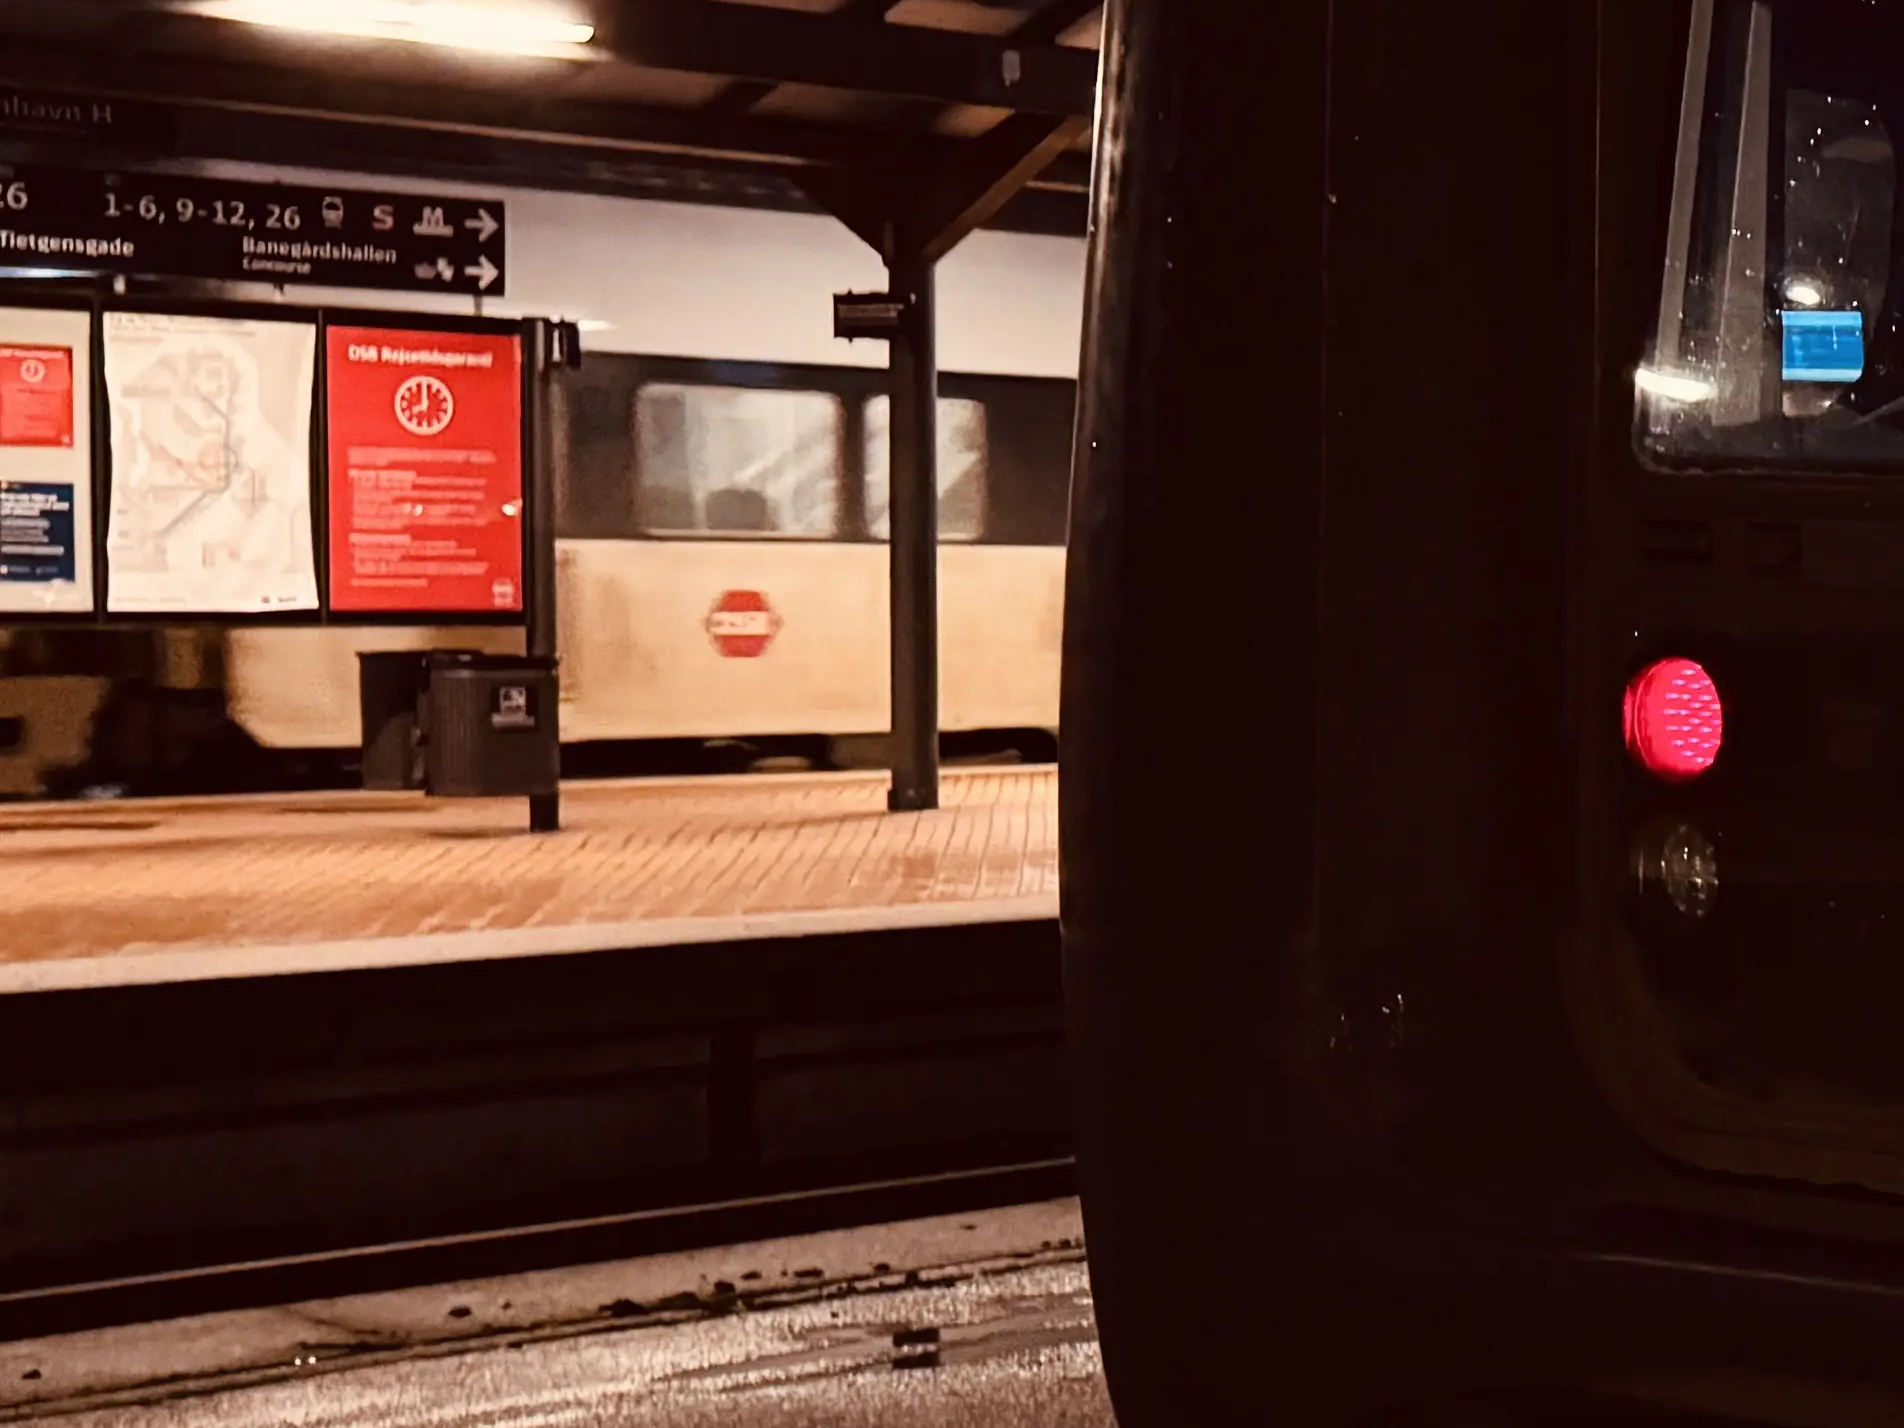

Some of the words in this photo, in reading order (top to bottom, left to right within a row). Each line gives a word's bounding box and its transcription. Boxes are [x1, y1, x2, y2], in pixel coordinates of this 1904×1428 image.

[92, 103, 114, 125] H
[104, 192, 166, 225] 1-6,
[176, 198, 255, 231] 9-12,
[265, 204, 301, 230] 26
